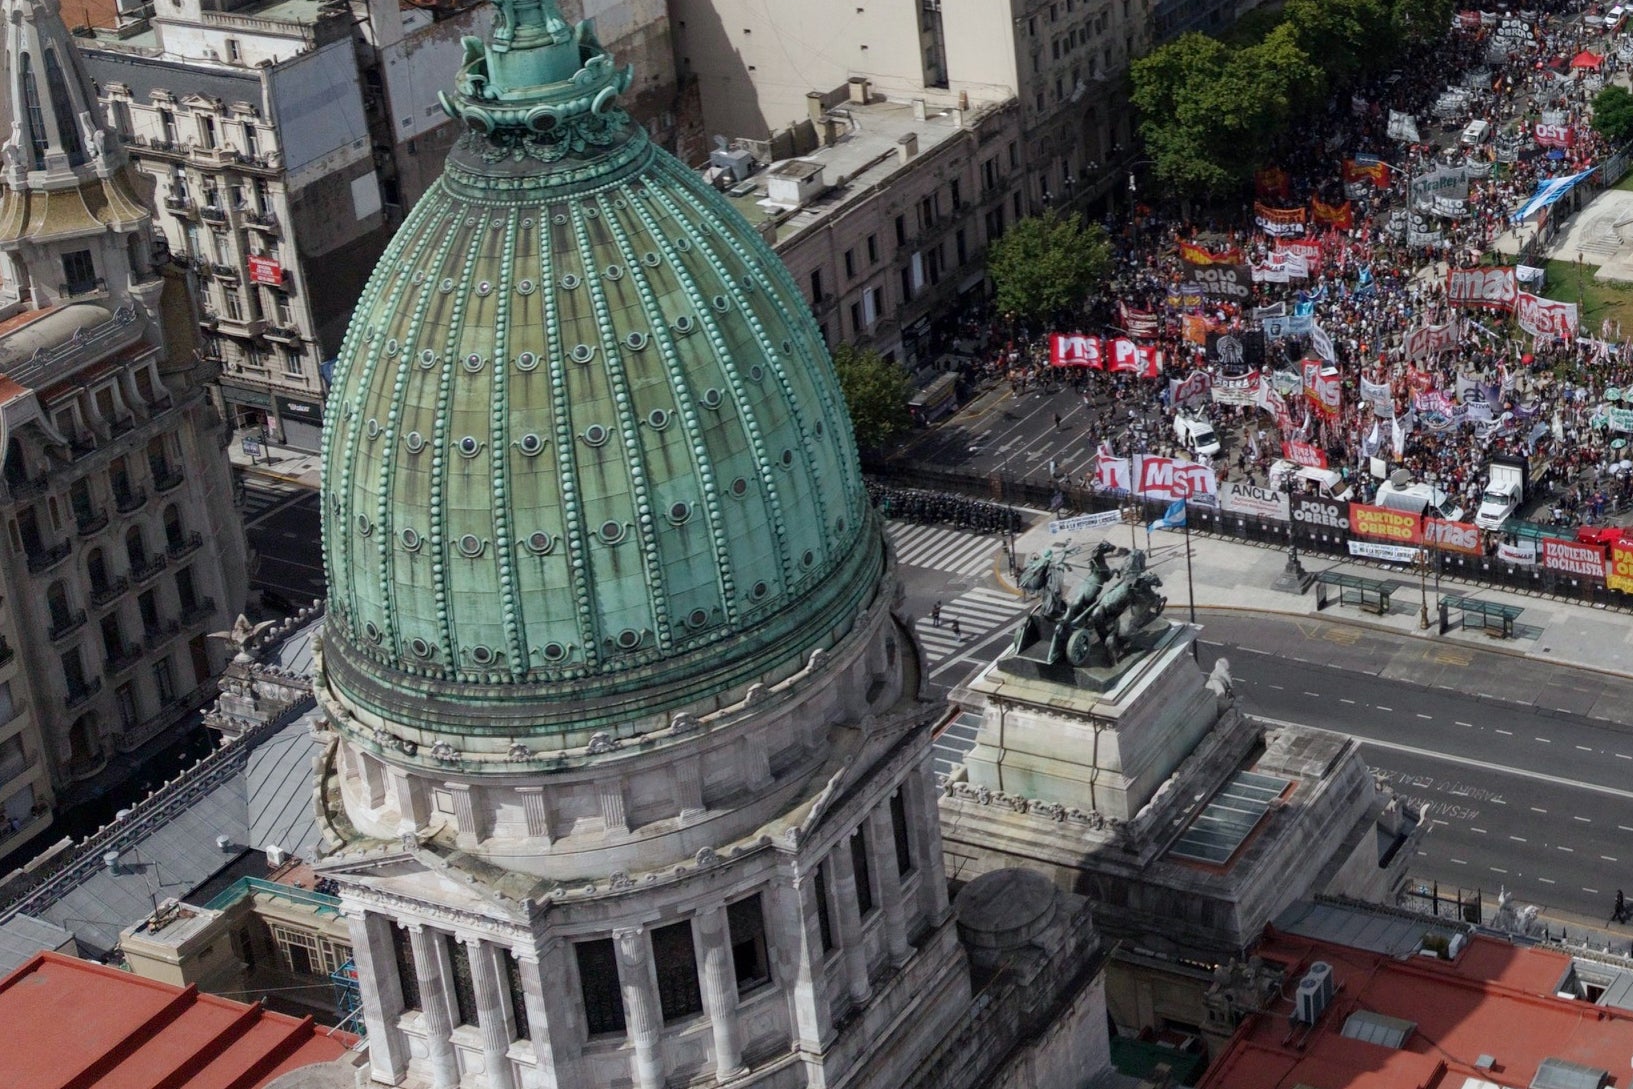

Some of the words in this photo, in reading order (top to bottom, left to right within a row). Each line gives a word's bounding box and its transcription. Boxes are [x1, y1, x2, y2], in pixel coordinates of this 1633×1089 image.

[1502, 20, 1529, 31] POLO
[1536, 125, 1568, 139] OST
[1435, 196, 1463, 208] POLO
[1195, 269, 1237, 282] POLO
[1520, 298, 1569, 331] MST
[1058, 335, 1099, 360] PTS
[1145, 462, 1207, 497] MST
[1231, 483, 1281, 503] ANCLA
[1301, 500, 1339, 517] POLO
[1293, 510, 1349, 529] OBRERO
[1356, 510, 1415, 527] PARTIDO
[1358, 522, 1413, 538] OBRERO
[1546, 542, 1601, 564] IZQUIERDA
[1546, 555, 1604, 577] SOCIALISTA
